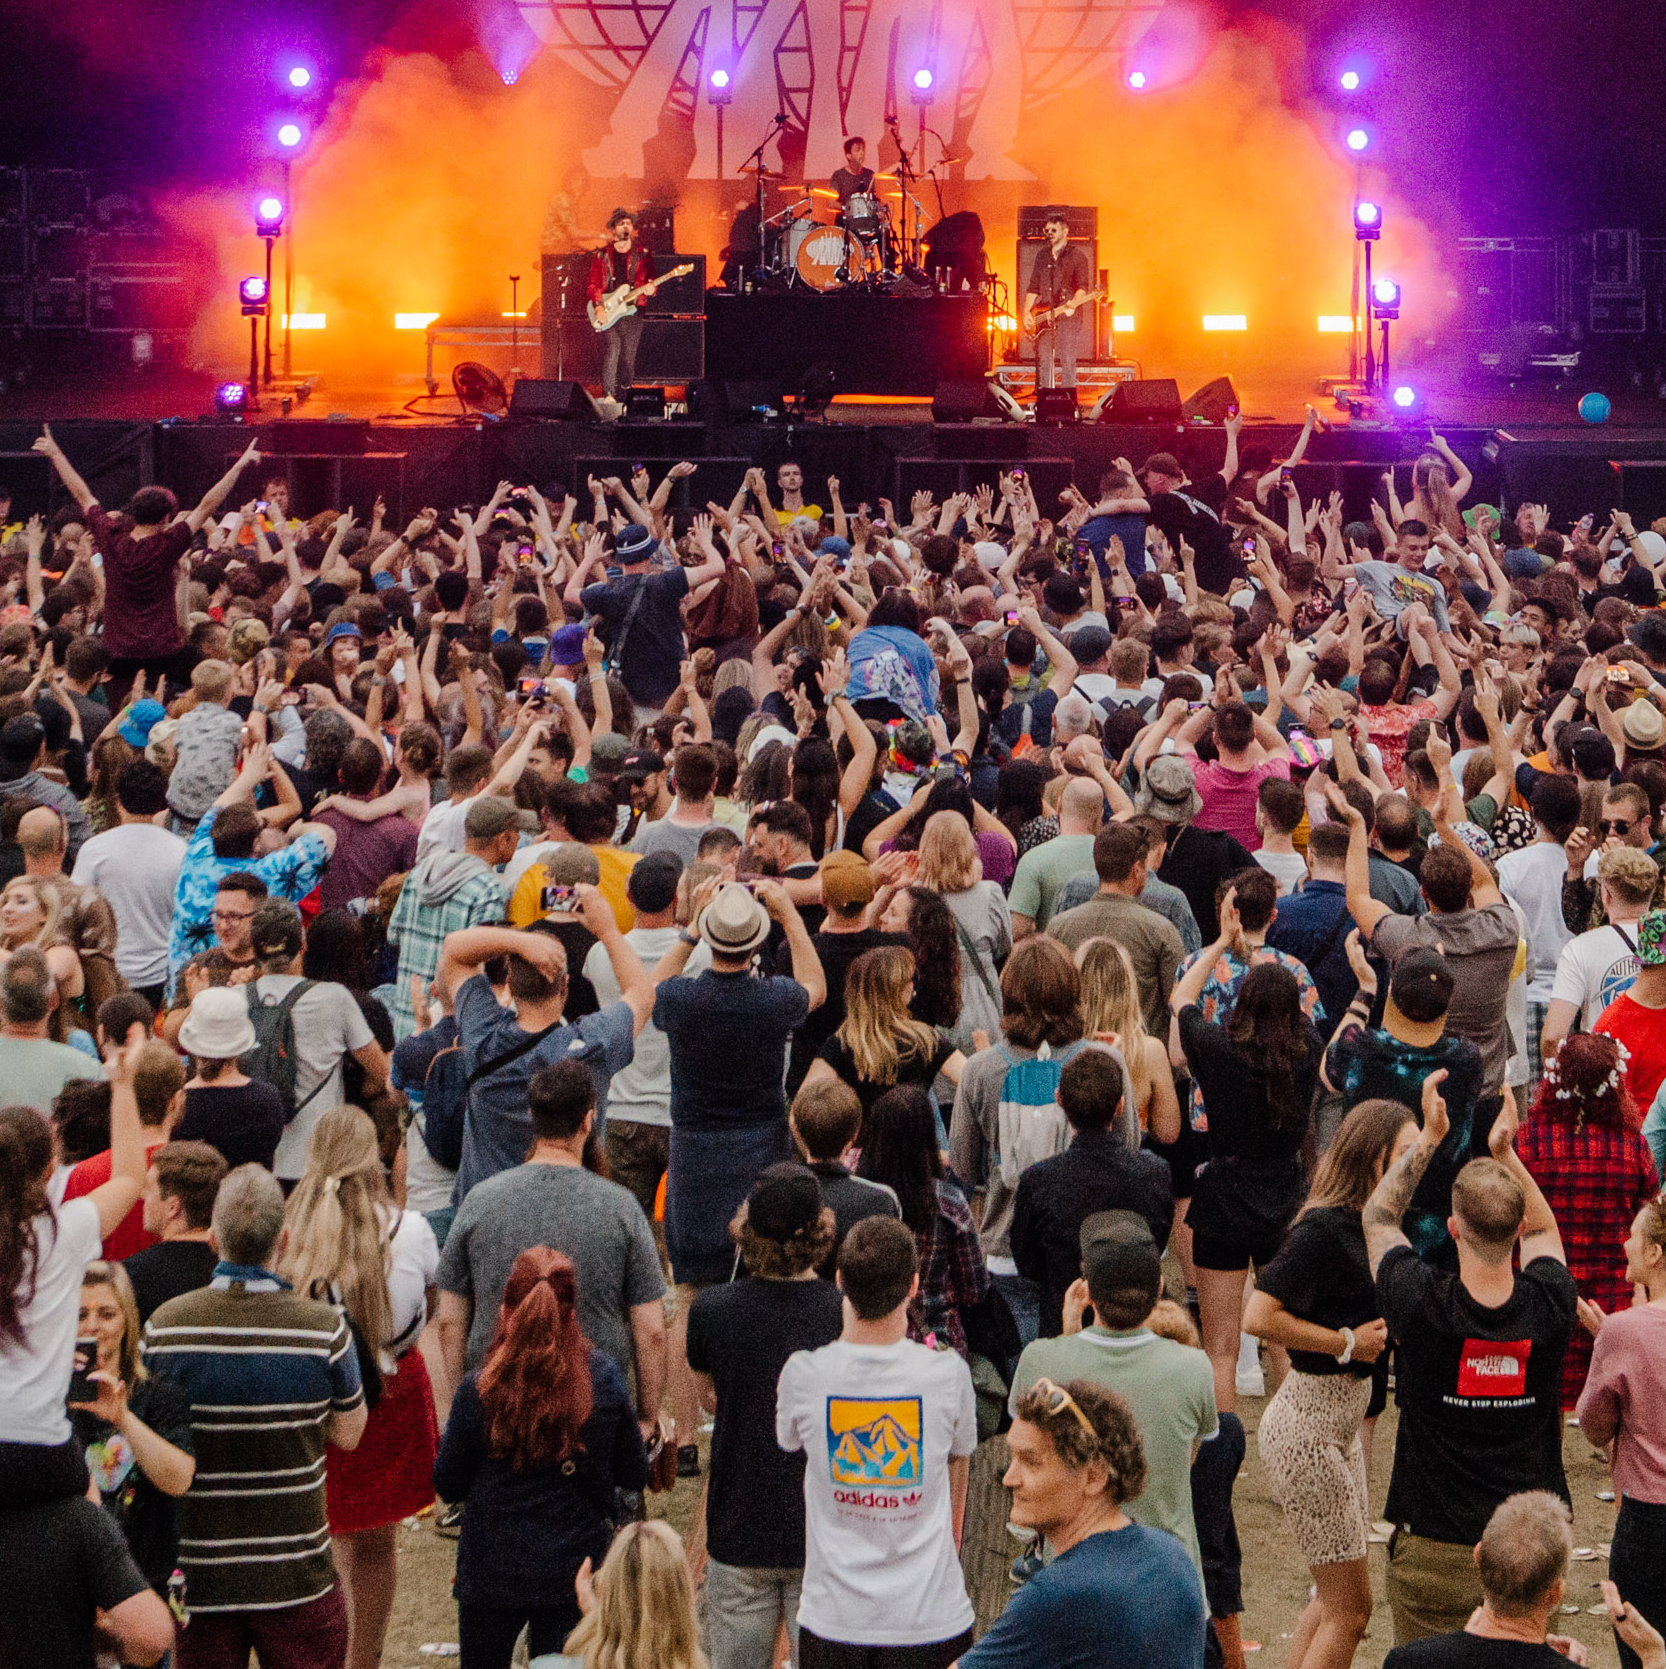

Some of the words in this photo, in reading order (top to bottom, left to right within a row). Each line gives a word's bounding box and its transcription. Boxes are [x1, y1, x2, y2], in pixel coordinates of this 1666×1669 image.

[1466, 1357, 1502, 1368] NORTH
[1475, 1366, 1502, 1376] FACE
[1442, 1395, 1469, 1408] NEVER
[1471, 1399, 1491, 1408] STOP
[1493, 1396, 1536, 1408] EXPLORING
[834, 1490, 900, 1508] adidas
